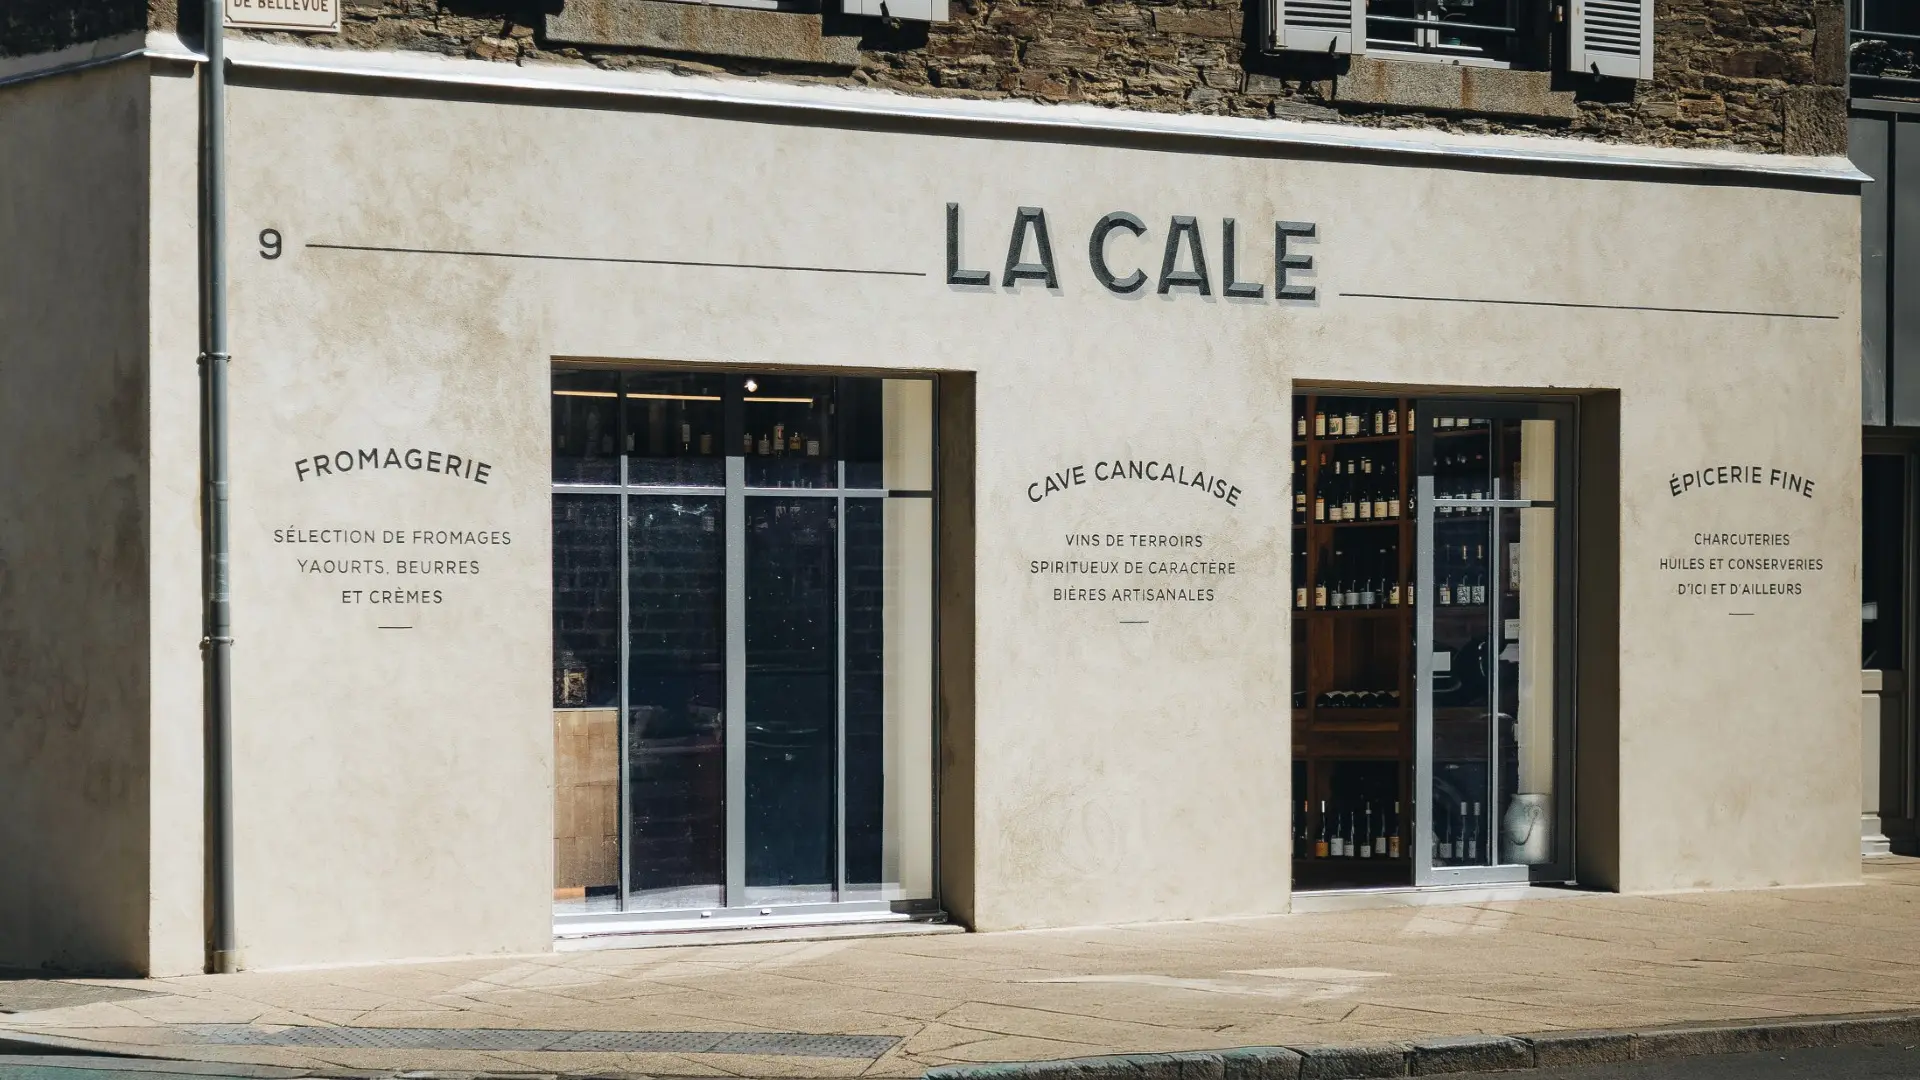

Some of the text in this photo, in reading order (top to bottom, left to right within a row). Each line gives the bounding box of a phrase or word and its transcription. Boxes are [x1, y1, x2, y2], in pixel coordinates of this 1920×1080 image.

[258, 228, 283, 261] 9
[946, 202, 1317, 301] LA CALE
[294, 447, 492, 485] FROMAGERIE
[1027, 460, 1243, 507] CAVE CANCALAISE
[1668, 465, 1816, 499] ÉPICERIE FINE
[273, 524, 512, 545] SÉLECTION DE FROMAGES
[1065, 533, 1204, 548] VINS DE TERROIRS
[1694, 532, 1791, 546] CHARCUTERIES
[396, 560, 481, 575] BEURRES
[1030, 558, 1236, 575] SPIRITUEUX DE CARACTÈRE
[1659, 557, 1824, 571] HUILES ET CONSERVERIES
[341, 586, 443, 604] ET CRÈMES
[1053, 585, 1215, 602] BIÈRES ARTISANALES
[1678, 582, 1802, 596] D'ICI ET D'AILLEURS
